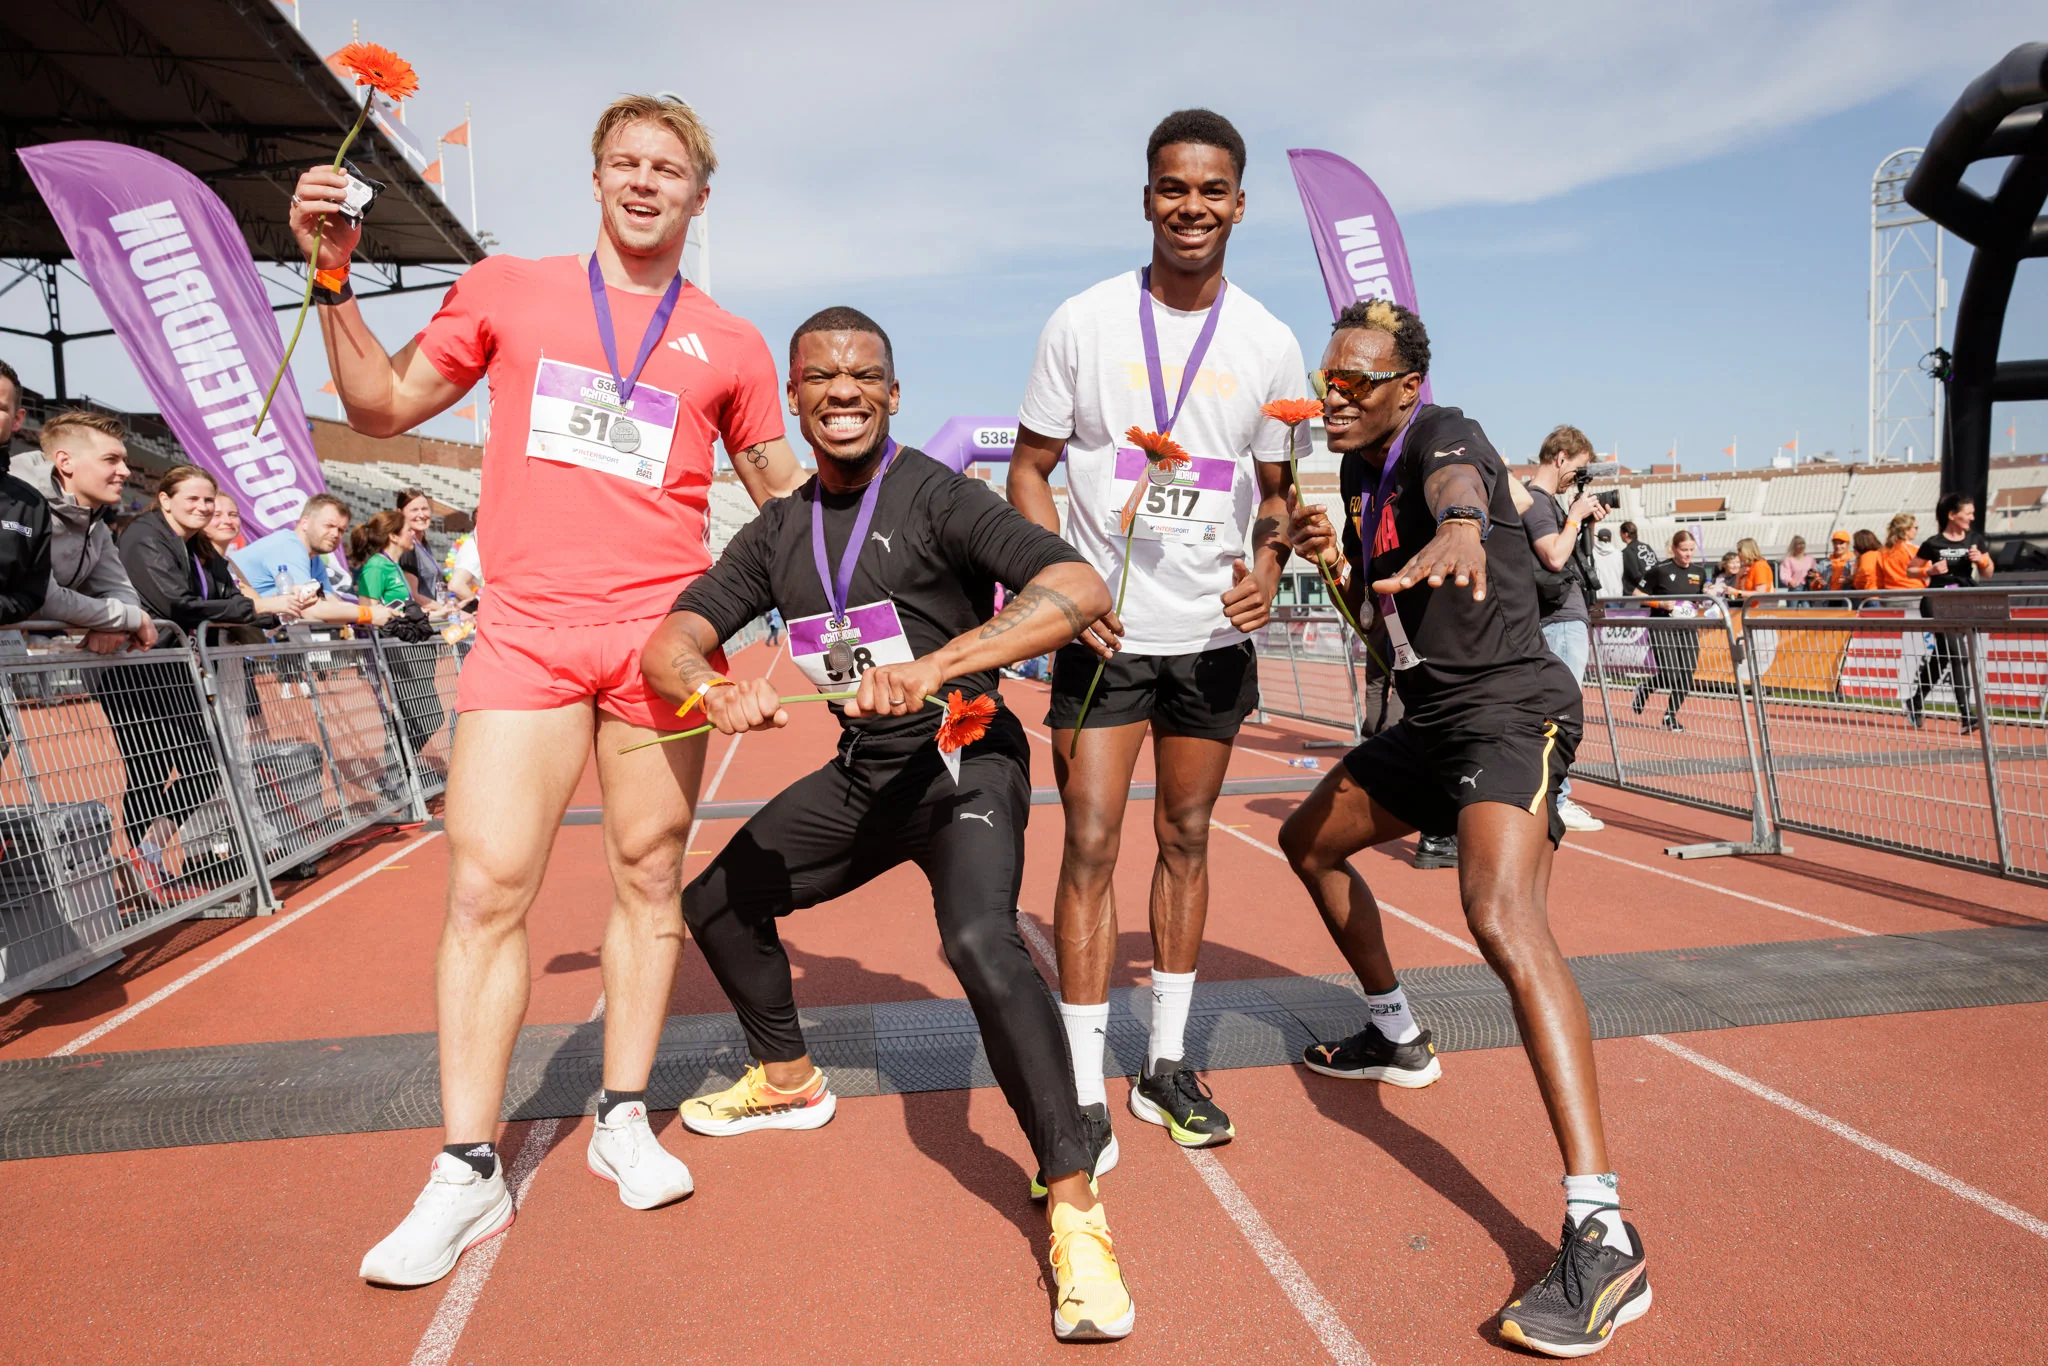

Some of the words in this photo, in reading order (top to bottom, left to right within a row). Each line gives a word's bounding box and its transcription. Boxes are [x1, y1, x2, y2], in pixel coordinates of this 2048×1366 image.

[568, 405, 633, 442] 51
[980, 431, 1008, 444] 538
[1146, 485, 1200, 517] 517
[1156, 525, 1190, 534] INTERSPORT
